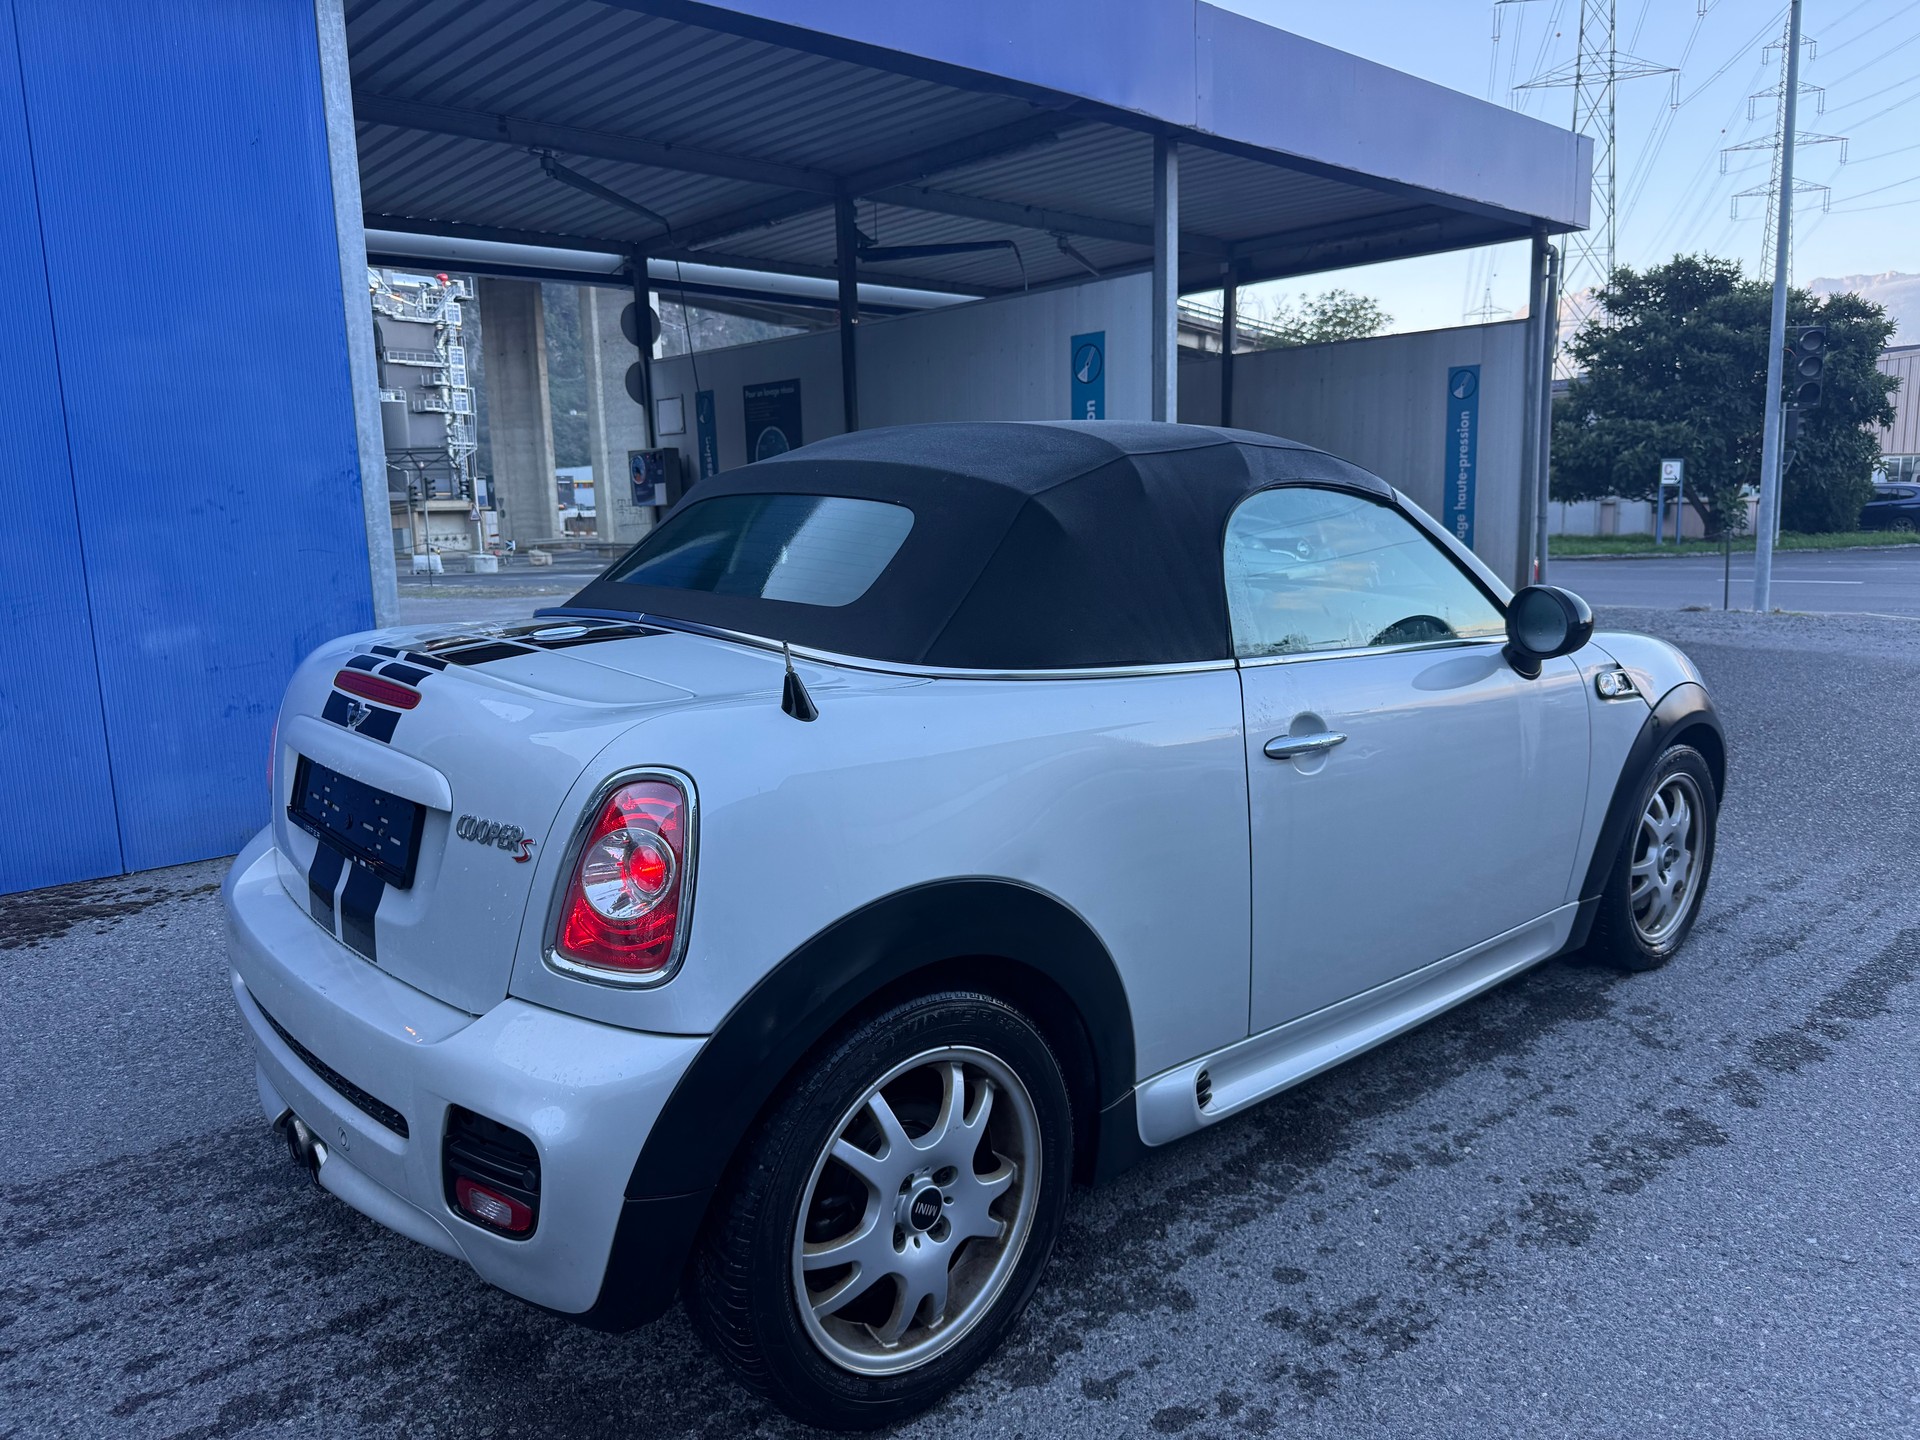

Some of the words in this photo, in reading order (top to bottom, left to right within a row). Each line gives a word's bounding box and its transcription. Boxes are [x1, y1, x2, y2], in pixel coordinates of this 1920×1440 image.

[1453, 411, 1472, 510] haute-pression
[1664, 463, 1673, 475] C
[1456, 514, 1468, 541] age
[456, 814, 525, 852] COOPER
[512, 838, 537, 863] S
[914, 1201, 938, 1217] MINI
